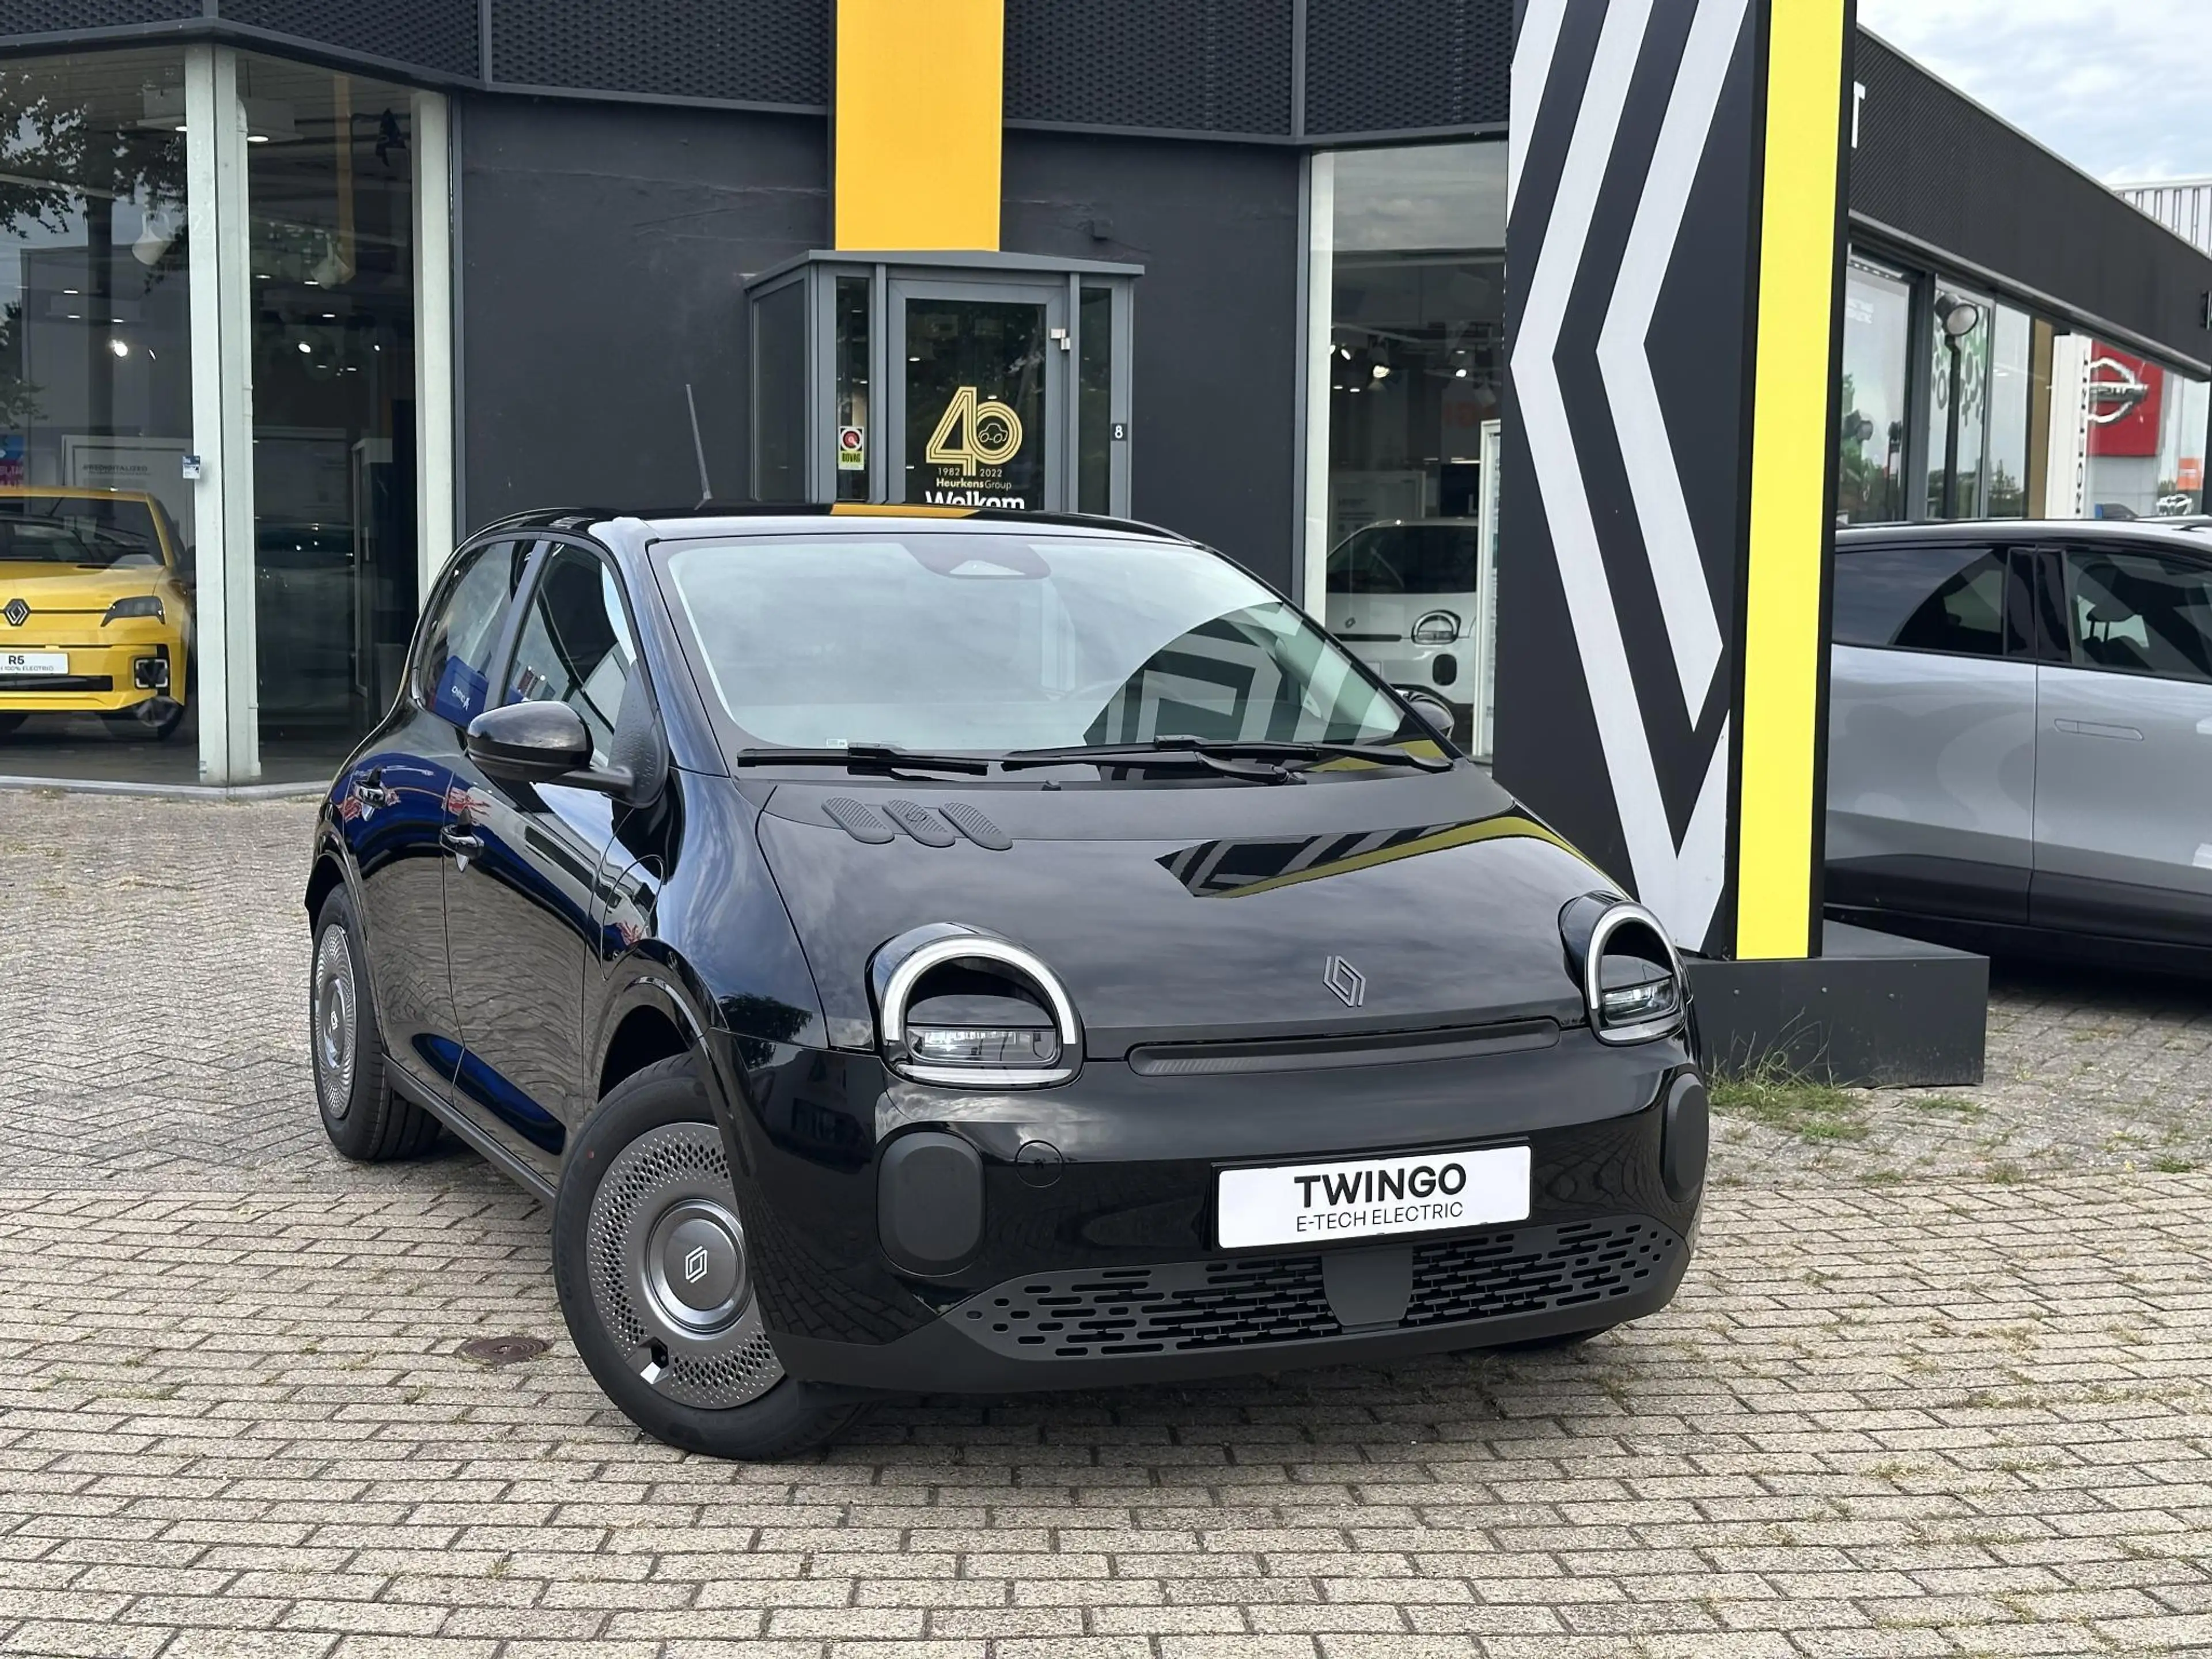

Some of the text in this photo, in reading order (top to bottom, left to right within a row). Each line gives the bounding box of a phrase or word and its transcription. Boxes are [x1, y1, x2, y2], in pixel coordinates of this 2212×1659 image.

[926, 387, 1022, 476] 40
[1115, 425, 1123, 438] 8
[938, 467, 1003, 478] 1982 2022
[9, 656, 25, 665] R5
[1294, 1163, 1467, 1208] TWINGO
[1297, 1202, 1463, 1232] E-TECH ELECTRIC
